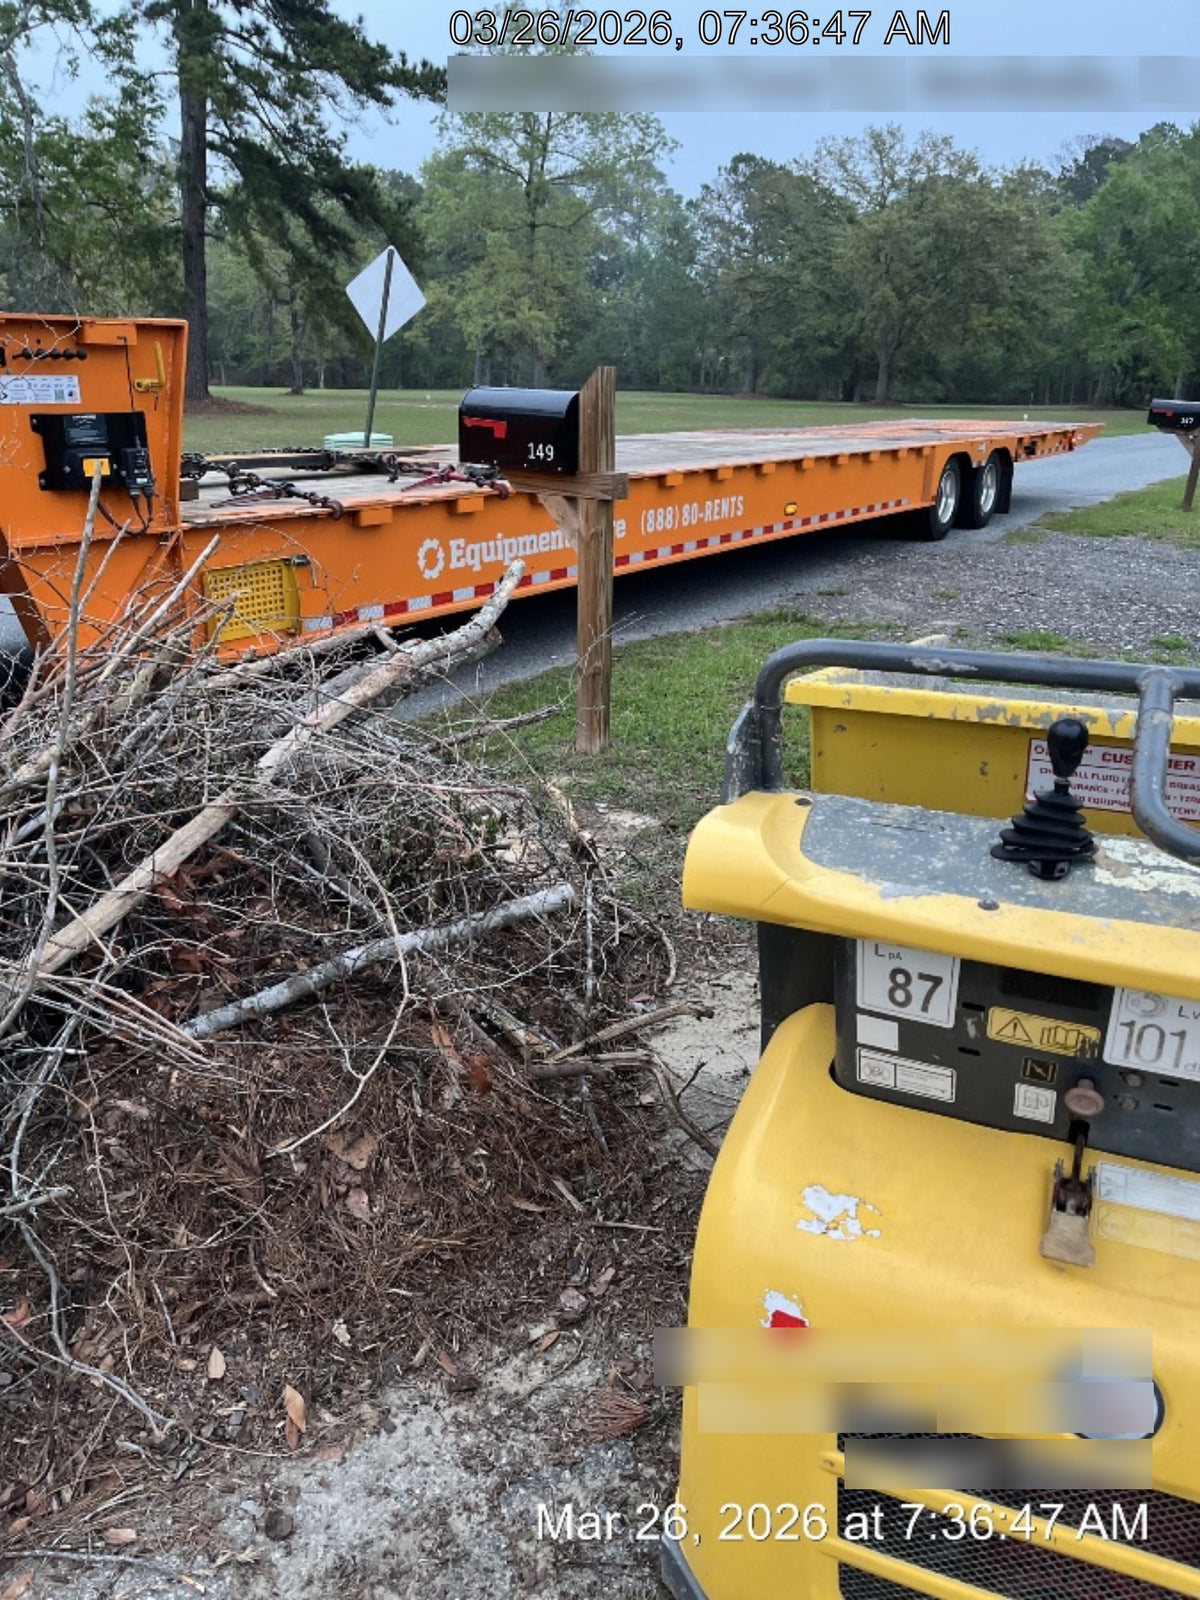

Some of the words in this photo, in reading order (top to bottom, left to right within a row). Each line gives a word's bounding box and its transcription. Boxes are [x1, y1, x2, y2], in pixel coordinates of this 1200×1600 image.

[527, 442, 553, 461] 149
[641, 504, 680, 536] (888)
[682, 495, 744, 527] 80-RENTS
[888, 966, 943, 1014] 87
[1119, 1020, 1187, 1069] 101
